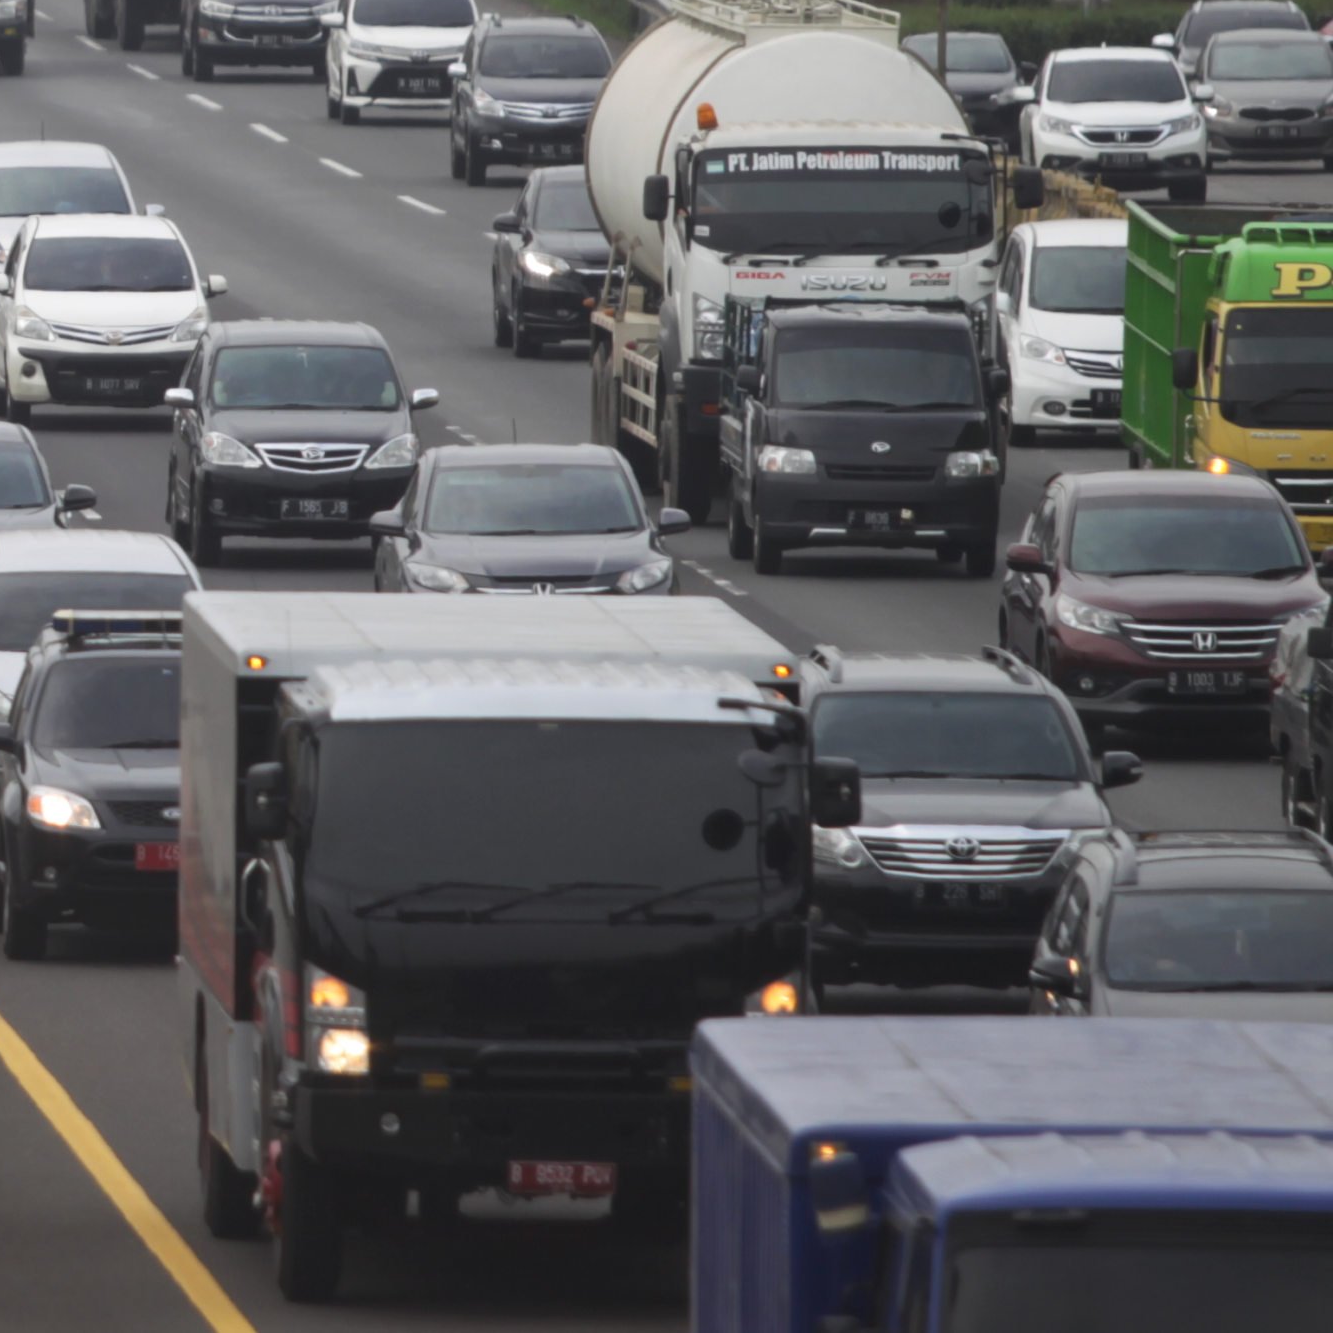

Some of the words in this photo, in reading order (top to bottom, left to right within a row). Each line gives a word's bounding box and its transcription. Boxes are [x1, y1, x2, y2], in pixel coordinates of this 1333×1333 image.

[728, 152, 750, 172] PT.
[752, 151, 794, 171] Jatim
[796, 150, 880, 170] Petroleum
[881, 150, 961, 172] Transport
[735, 271, 786, 280] GIGA
[800, 274, 888, 292] ISUZU
[511, 1163, 522, 1184] B
